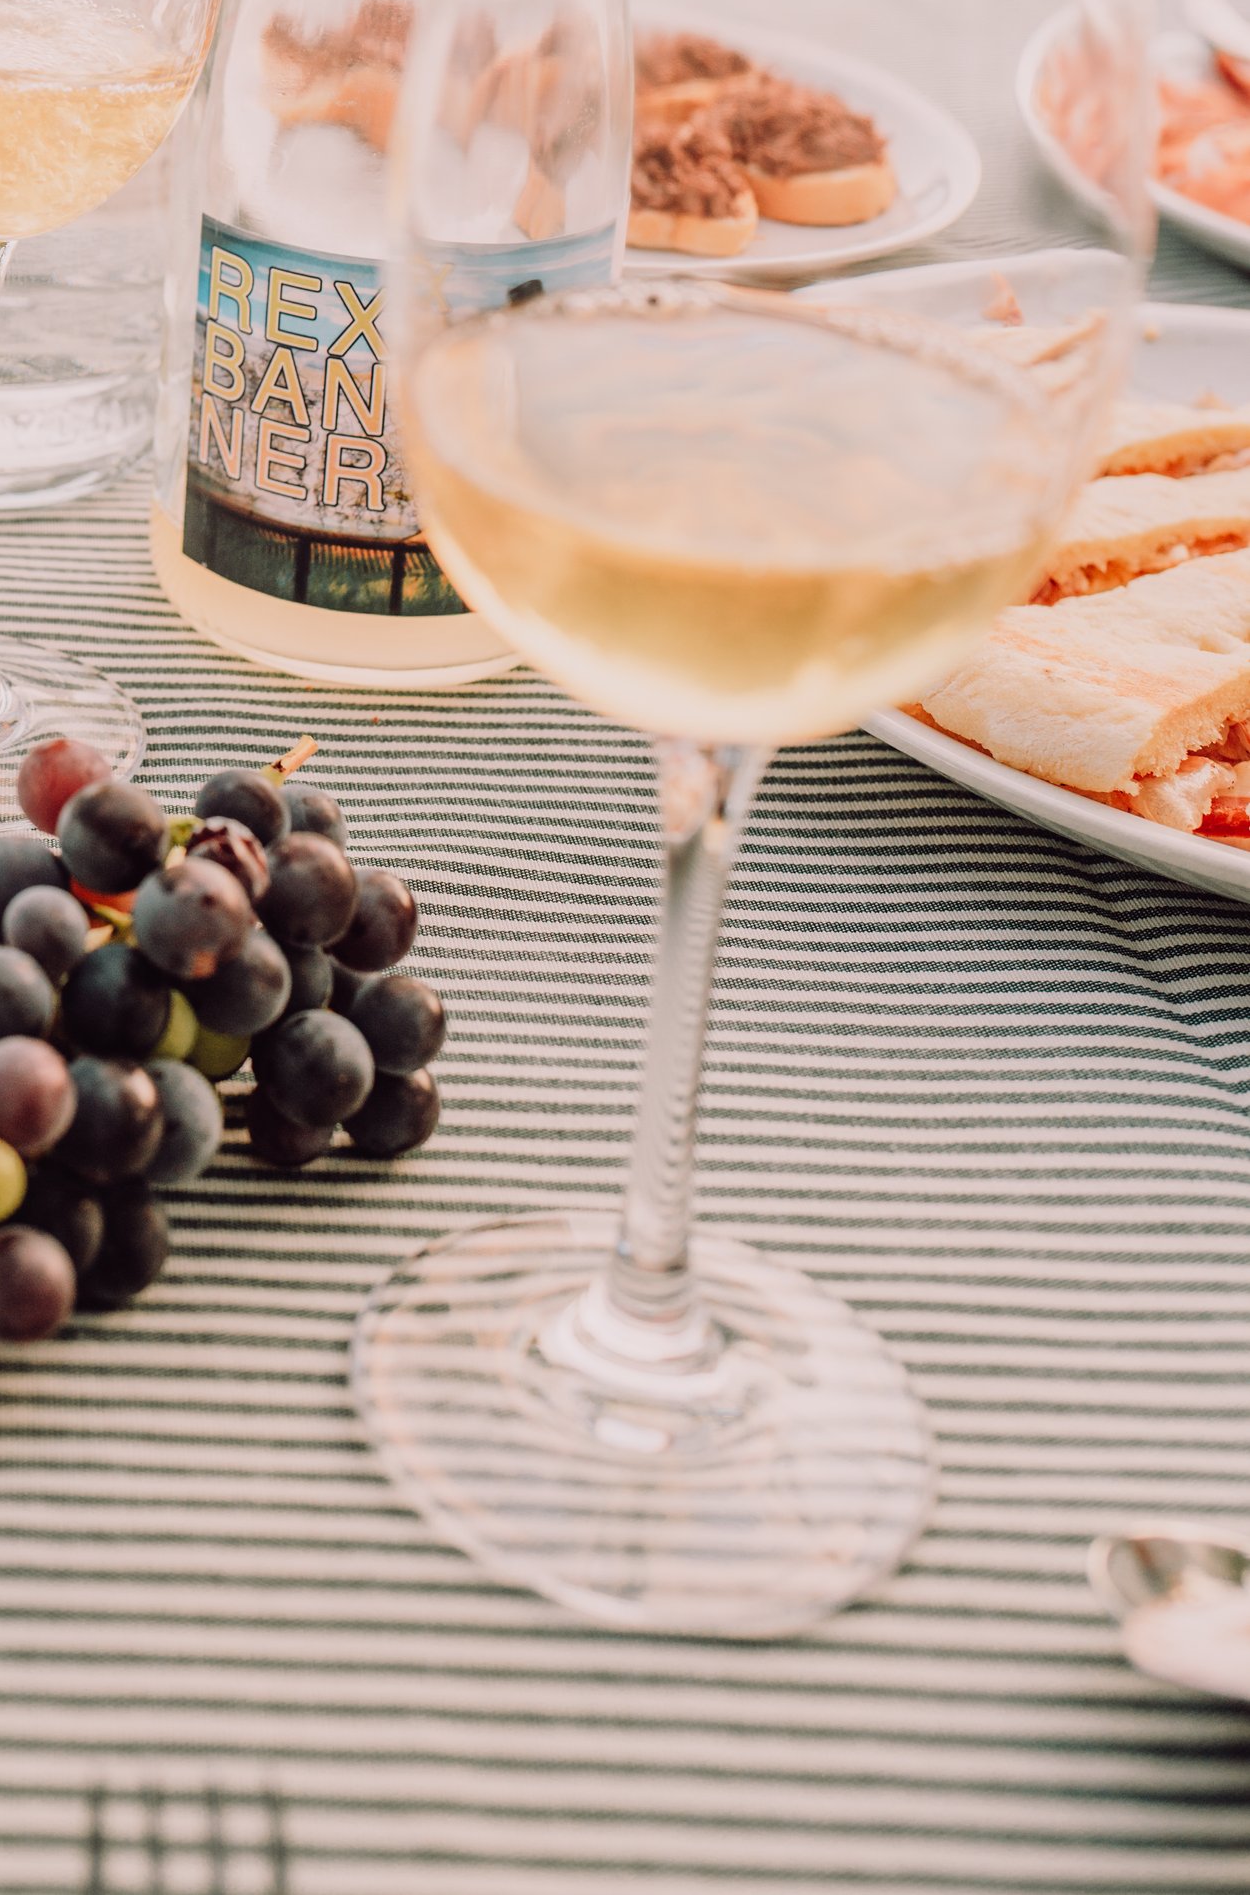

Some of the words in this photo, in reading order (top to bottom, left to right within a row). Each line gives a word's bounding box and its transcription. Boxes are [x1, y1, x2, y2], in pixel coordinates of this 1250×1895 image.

[209, 245, 391, 361] REX
[202, 318, 387, 437] BAN
[197, 392, 388, 512] NER
